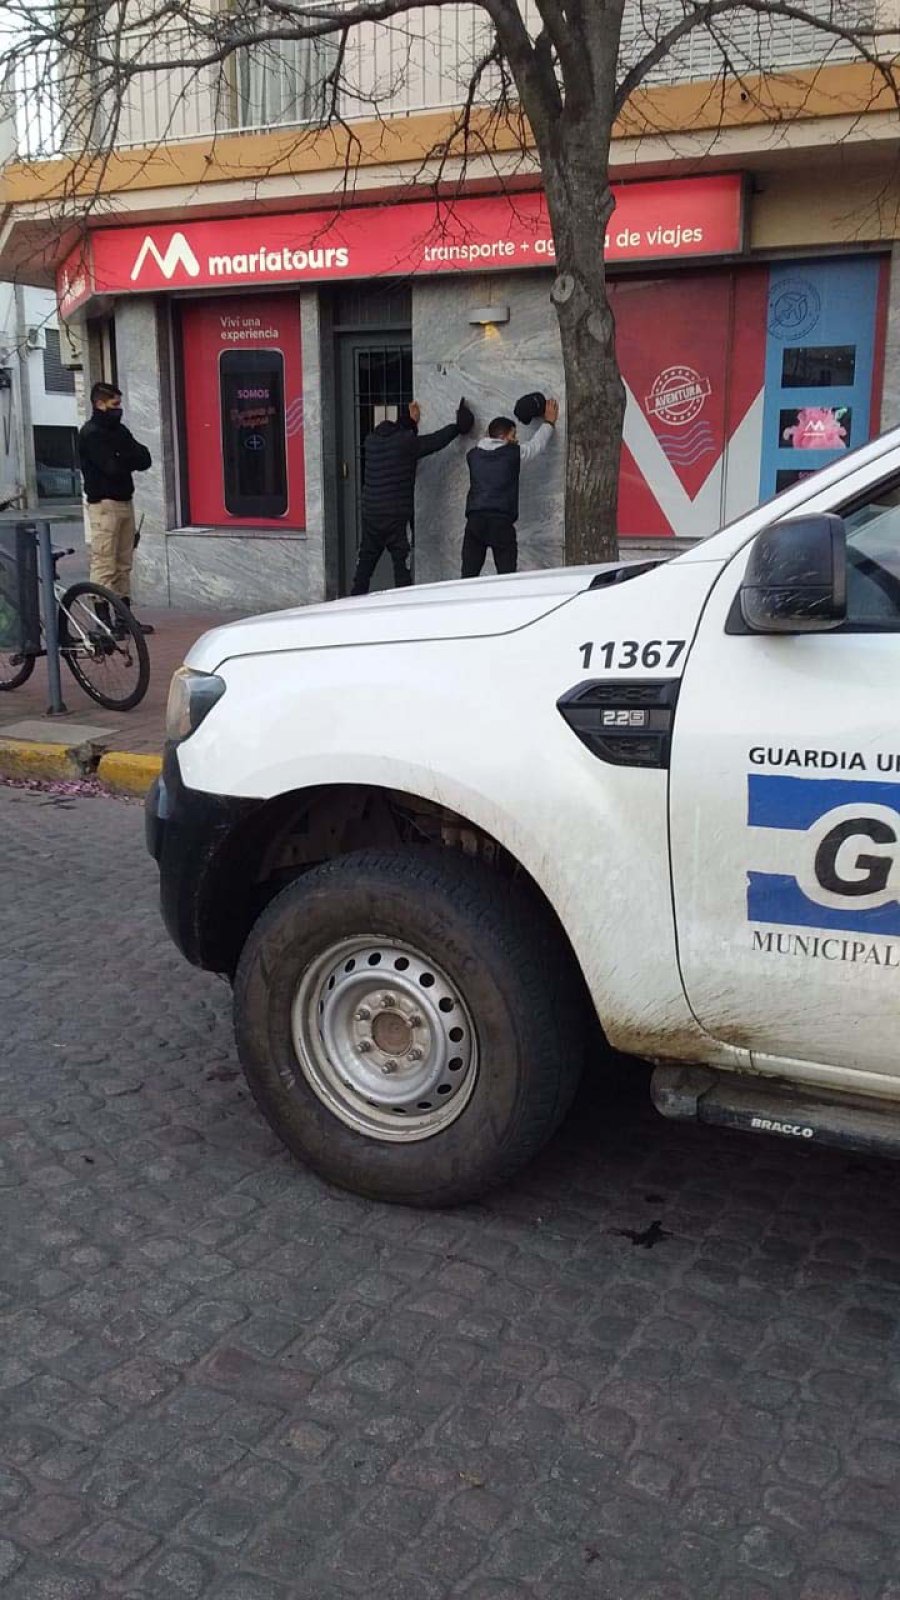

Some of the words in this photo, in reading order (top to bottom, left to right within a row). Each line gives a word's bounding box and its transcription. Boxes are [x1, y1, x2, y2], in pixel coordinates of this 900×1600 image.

[424, 241, 515, 262] transporte
[616, 228, 640, 247] de
[647, 225, 703, 249] viajes
[208, 246, 349, 276] maríatours
[220, 327, 279, 342] experiencia
[242, 318, 261, 327] una
[237, 389, 270, 399] SOMOS
[655, 383, 703, 408] AVENTURA
[578, 639, 686, 670] 11367
[748, 746, 866, 772] GUARDIA
[814, 817, 898, 896] G
[752, 930, 900, 967] MUNICIPAL
[750, 1118, 814, 1139] BRACCO
